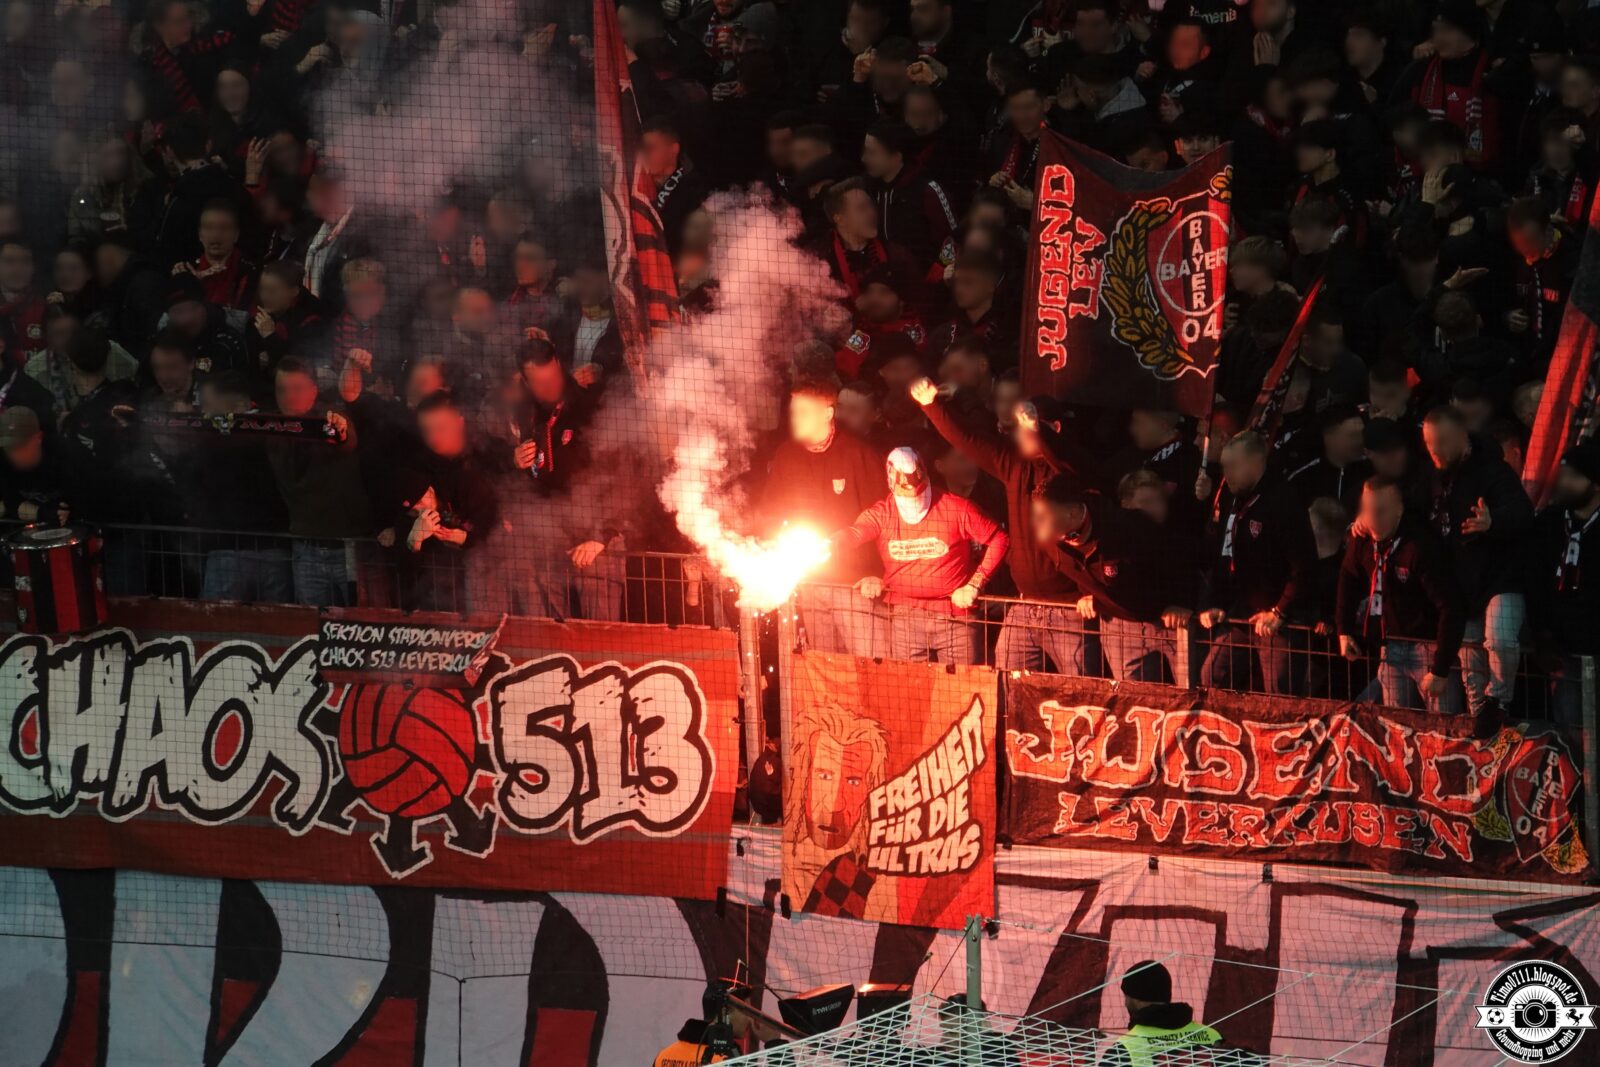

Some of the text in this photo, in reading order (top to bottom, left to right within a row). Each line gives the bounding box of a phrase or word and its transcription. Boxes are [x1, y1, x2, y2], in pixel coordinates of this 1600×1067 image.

[1038, 164, 1075, 371] JUGEND
[1068, 216, 1107, 320] LEV
[1161, 246, 1228, 281] BAYER
[1189, 219, 1206, 309] BAYER
[1182, 312, 1220, 343] 04
[319, 646, 472, 672] CHAOS 513 LEVERKU
[322, 621, 384, 642] SEKTION
[0, 628, 715, 845] CHAOS 513
[869, 695, 985, 820] FREIHEIT
[1006, 700, 1496, 817] JUGEND
[869, 778, 969, 846] FÜR DIE
[1515, 767, 1563, 799] BAYE
[867, 823, 981, 874] ULTRAS
[1053, 792, 1473, 863] LEVERKUSEN
[1516, 815, 1548, 849] 04
